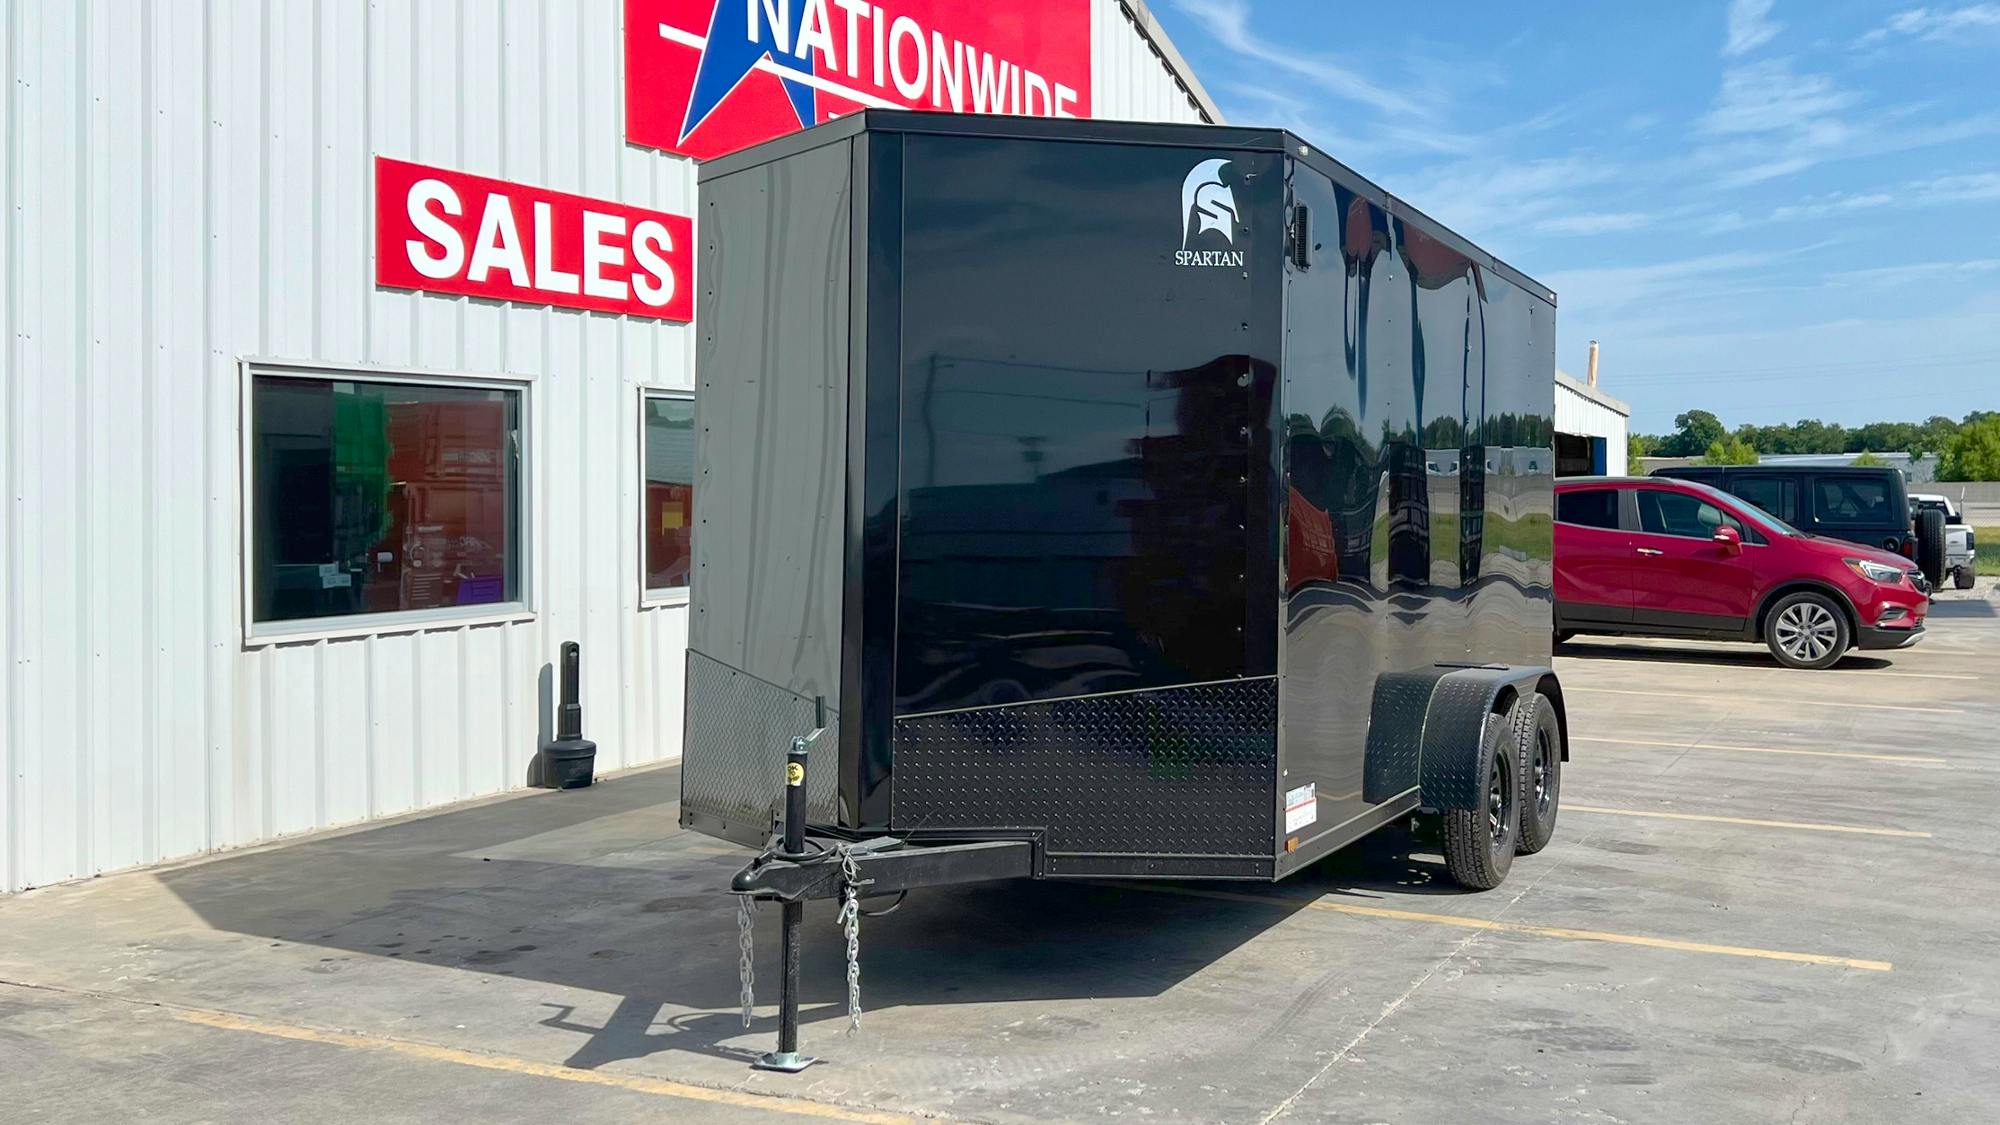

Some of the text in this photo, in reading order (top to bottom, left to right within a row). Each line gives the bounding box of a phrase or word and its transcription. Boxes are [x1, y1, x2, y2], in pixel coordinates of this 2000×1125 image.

[747, 0, 1078, 118] NATIONWIDE
[405, 179, 675, 306] SALES
[1175, 250, 1244, 267] SPARTAN
